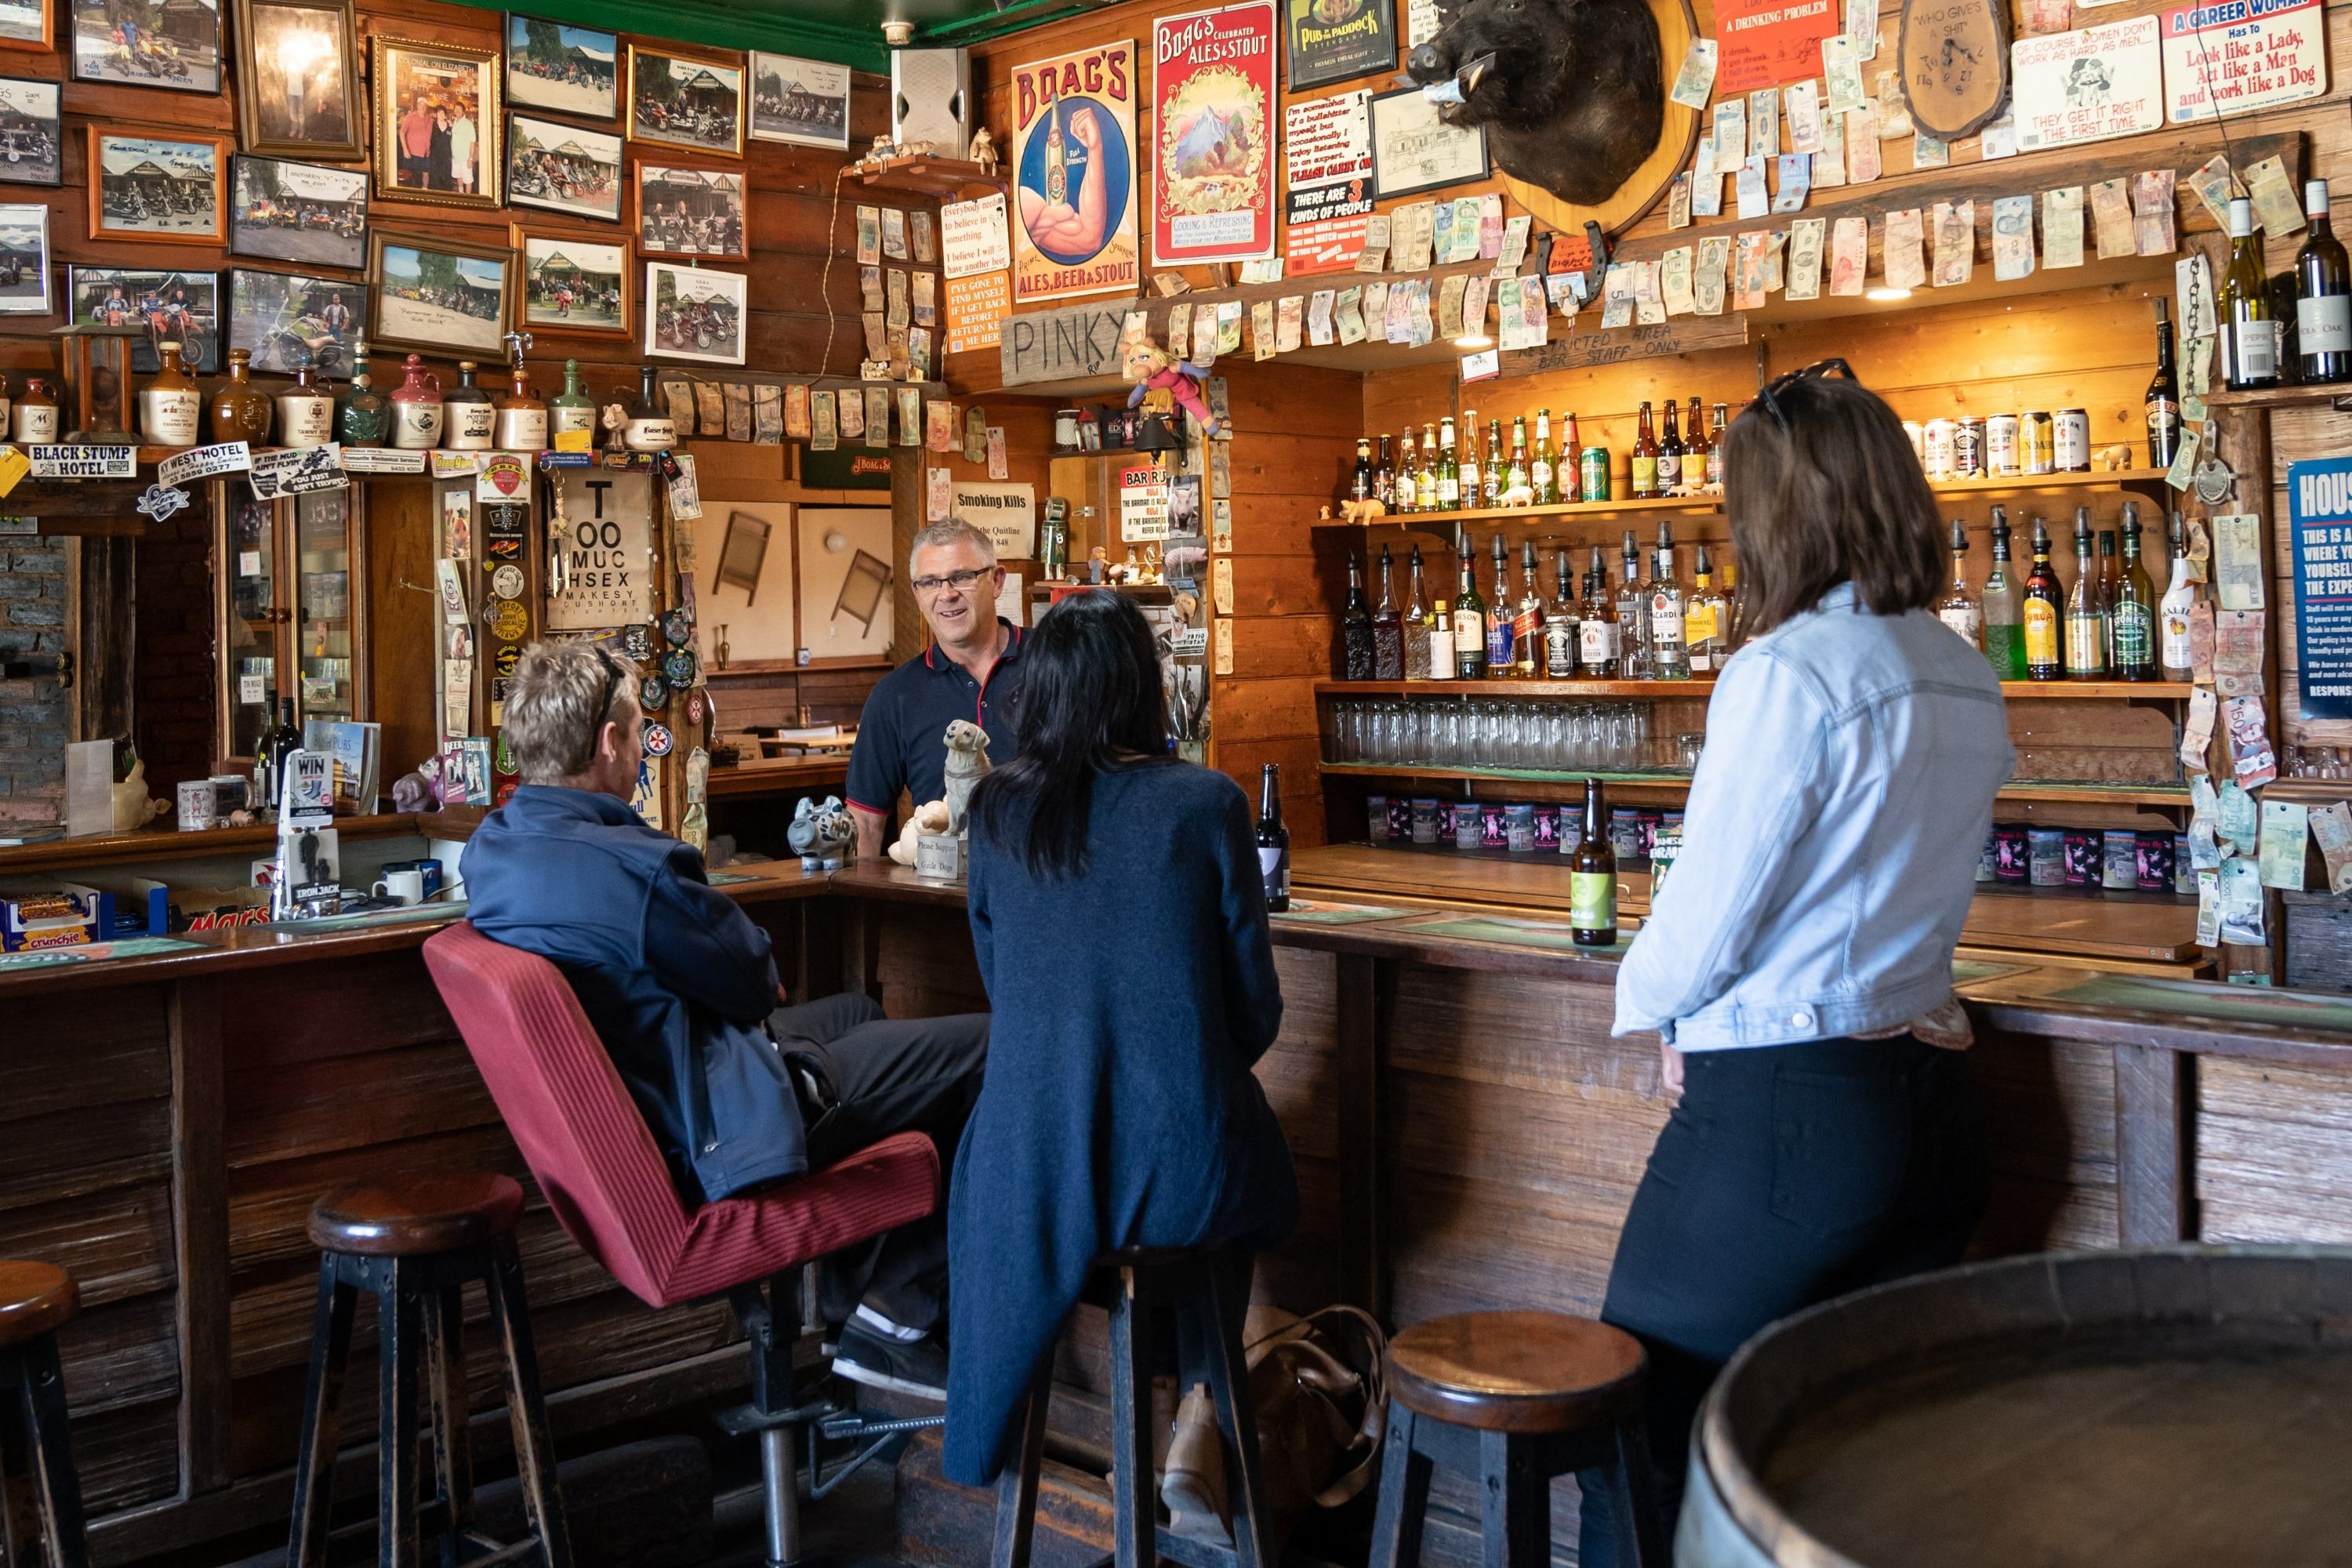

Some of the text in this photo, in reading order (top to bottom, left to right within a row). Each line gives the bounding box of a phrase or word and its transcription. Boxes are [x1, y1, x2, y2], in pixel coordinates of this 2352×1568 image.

[1726, 0, 1828, 33] A DRINKING PROBLEM
[2190, 1, 2245, 28] CAREER
[1214, 27, 1254, 40] CELEBRATED
[1301, 9, 1378, 52] PUB PADDOCK
[2228, 24, 2260, 38] Has To
[1159, 16, 1214, 64] BOAG'S
[1315, 33, 1363, 49] PYENGANA
[2016, 45, 2031, 56] OF
[2034, 37, 2075, 52] COURSE
[2080, 29, 2120, 45] WOMEN
[2186, 28, 2304, 67] Look like a Lady,
[1188, 35, 1267, 65] ALES STOUT
[1314, 49, 1368, 68] BOAGS DRAUGHT
[2017, 40, 2115, 67] WORK AS HARD AS
[398, 57, 474, 72] COLONIAL ELIZABETH
[2196, 51, 2297, 85] Act like a Man
[1018, 50, 1127, 132] BOAG'S
[2180, 86, 2205, 107] and
[2212, 80, 2243, 101] work
[2247, 73, 2272, 95] like
[2277, 76, 2285, 88] a
[2289, 65, 2316, 86] Dog
[1303, 98, 1346, 113] somewhat
[2032, 98, 2146, 129] THEY GET IT RIGHT
[1288, 108, 1351, 127] of bullshitter
[1319, 122, 1334, 131] but
[2043, 125, 2067, 143] THE
[2072, 120, 2103, 136] FIRST
[2110, 115, 2136, 130] TIME
[1289, 131, 1341, 147] occasionally
[1290, 140, 1351, 158] enjoy listening
[1066, 156, 1087, 166] STRENGTH
[1290, 165, 1325, 183] PLEASE
[1327, 159, 1358, 176] CARRY
[1294, 191, 1326, 208] THERE
[1326, 187, 1347, 202] ARE
[1348, 179, 1363, 203] 3
[944, 203, 979, 217] Everybody
[1290, 199, 1373, 225] KINDS OF PEOPLE
[954, 215, 987, 229] believe in
[1174, 215, 1252, 232] COOLING REFRESHING
[952, 245, 995, 262] believe will
[947, 259, 990, 275] have another
[1018, 254, 1041, 274] PRIME
[1054, 261, 1134, 290] BEER STOUT
[951, 275, 1004, 295] I'VE GONE TO
[951, 286, 1006, 305] FIND MYSELF
[967, 298, 1007, 313] GET BACK
[961, 311, 993, 325] BEFORE
[951, 323, 985, 338] RETURN
[1632, 325, 1672, 341] AREA
[966, 336, 979, 346] ME
[1014, 309, 1127, 375] PINKY
[1538, 339, 1681, 370] BAR STAFF ONLY
[1087, 361, 1101, 376] RIP
[33, 446, 131, 460] BLACK STUMP
[169, 445, 243, 470] WEST HOTEL
[263, 452, 298, 463] THE MUD
[59, 462, 105, 475] HOTEL
[169, 463, 230, 485] 03 5859 0277
[290, 473, 329, 485] YOU JUST
[1126, 471, 1149, 485] BAR
[585, 481, 612, 519] T
[957, 493, 1026, 510] Smoking Kills
[576, 521, 622, 550] OO
[993, 526, 1021, 536] Quitline
[2302, 528, 2342, 545] THIS IS
[572, 550, 625, 569] MUC
[2303, 545, 2339, 561] WHERE
[2303, 562, 2352, 579] YOURSEL
[2305, 580, 2325, 596] THE
[670, 678, 693, 688] POLICE
[333, 737, 352, 751] PUBS
[444, 740, 464, 756] BEER
[298, 758, 325, 775] WIN
[917, 840, 956, 853] Please Support
[939, 862, 953, 873] Dogs
[297, 884, 339, 899] IRON JACK
[188, 906, 271, 933] Mars
[29, 931, 80, 949] crunchie
